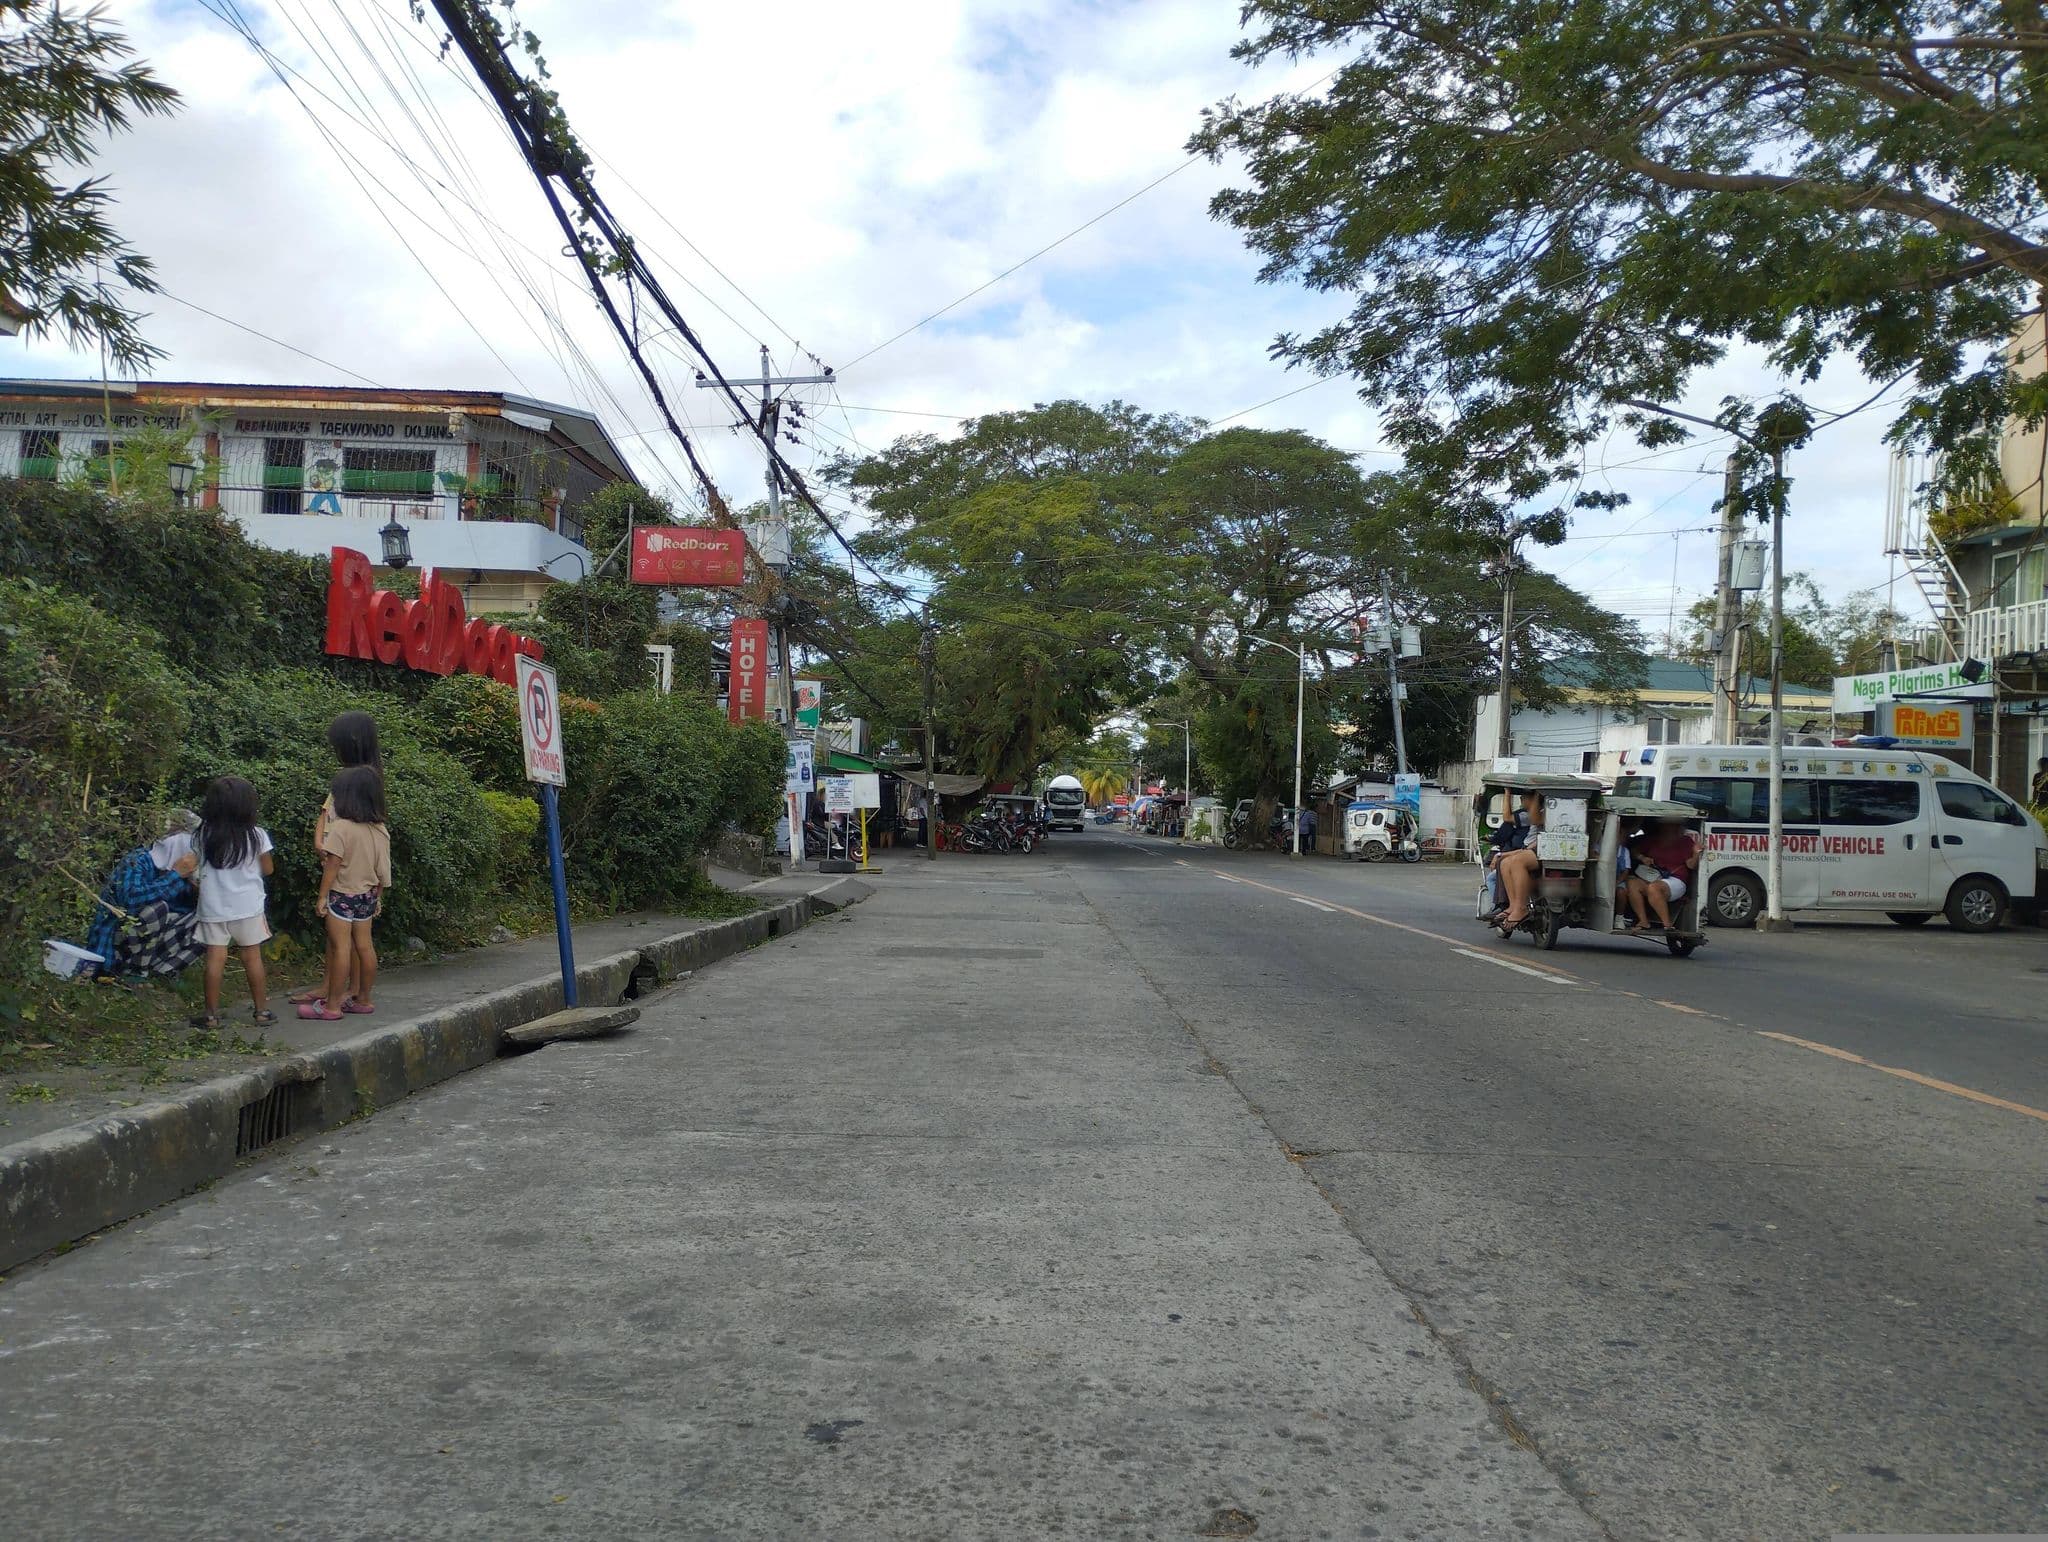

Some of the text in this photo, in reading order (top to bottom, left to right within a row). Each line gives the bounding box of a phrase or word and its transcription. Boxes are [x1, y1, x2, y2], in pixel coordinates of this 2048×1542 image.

[34, 412, 58, 427] ART
[62, 415, 80, 428] and
[319, 421, 395, 438] TAEKWONDO
[662, 538, 729, 551] RedDoorz
[739, 637, 755, 720] HOTEL
[1853, 678, 1885, 700] Naga
[1889, 671, 1944, 695] Pilgrims
[538, 750, 560, 774] PARKING
[1730, 834, 1819, 853] TRANPORT
[1823, 837, 1885, 855] VEHICLE
